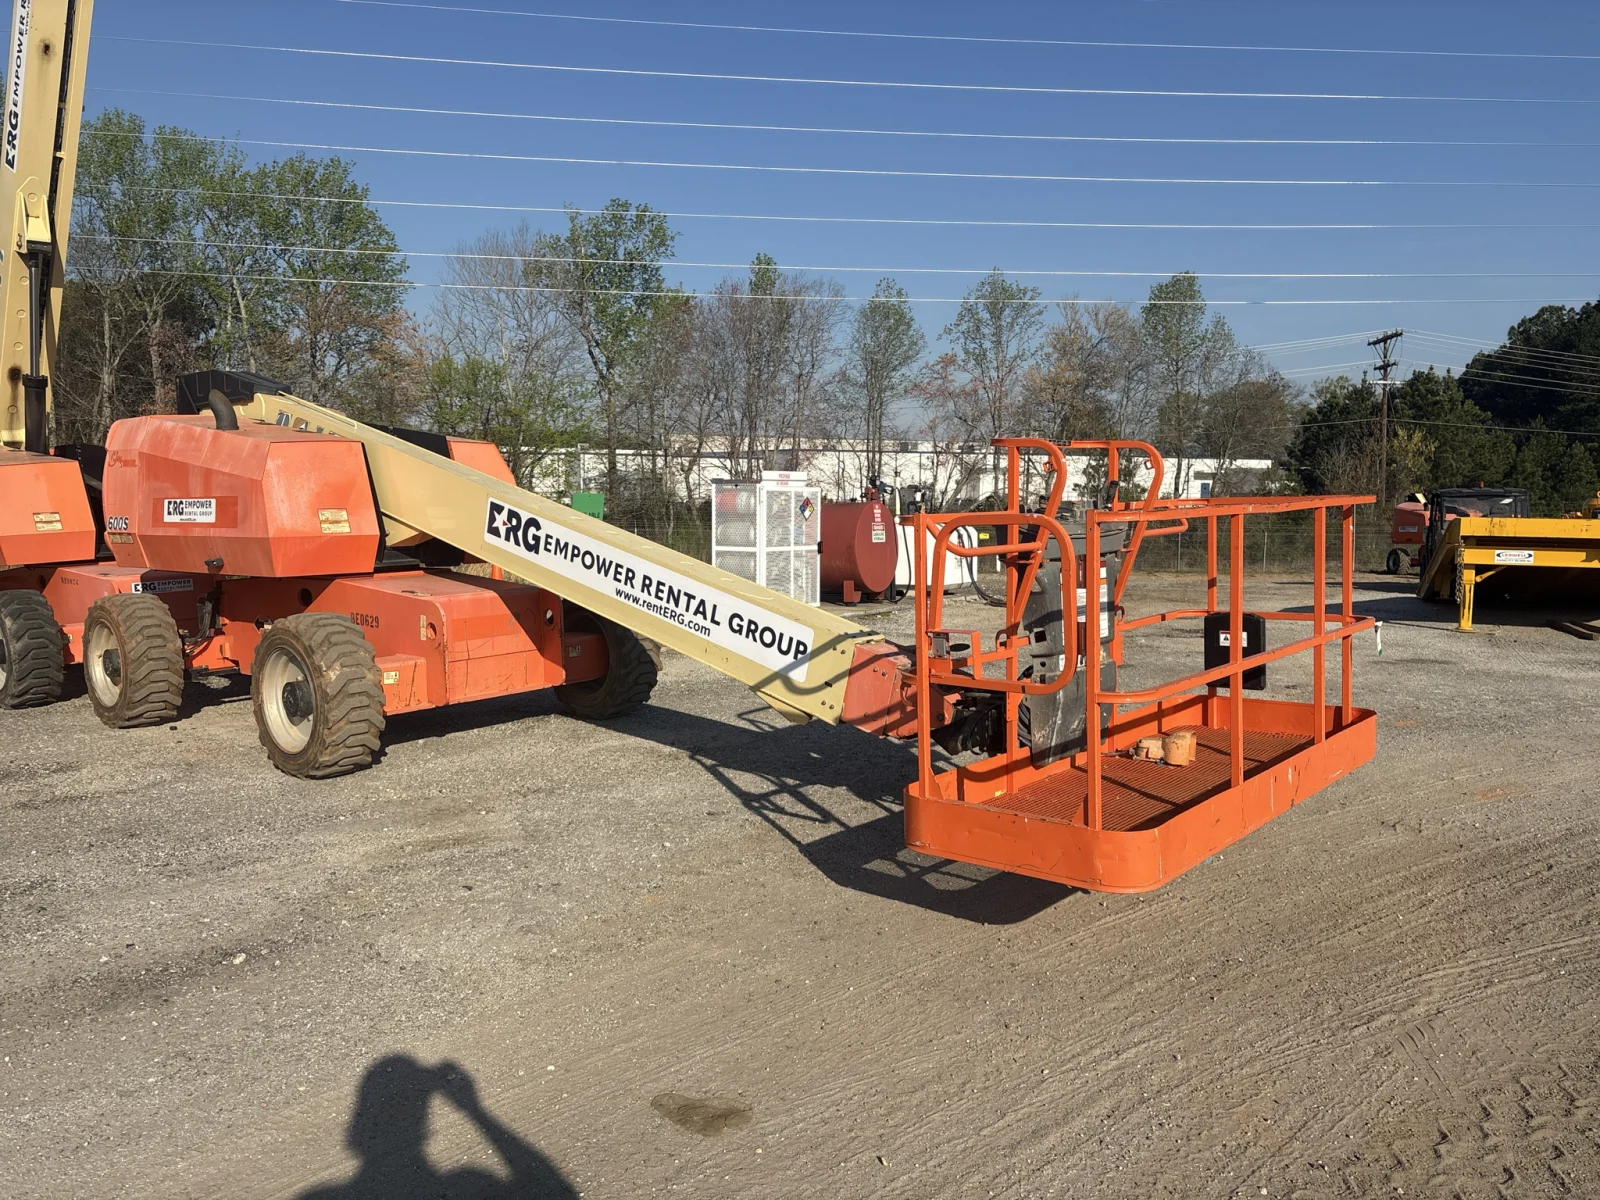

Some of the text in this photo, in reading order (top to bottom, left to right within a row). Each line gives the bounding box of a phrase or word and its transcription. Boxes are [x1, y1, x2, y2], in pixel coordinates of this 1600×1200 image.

[5, 109, 19, 170] ERG
[13, 15, 26, 107] EMPOWER
[166, 500, 212, 516] ERG EMPOWER
[108, 516, 129, 531] 600S
[134, 579, 191, 592] ERG EMPOWER
[487, 501, 808, 660] ERG EMPOWER RENTAL GROUP
[351, 612, 380, 628] BE0629
[615, 587, 711, 637] www.rentERG.com
